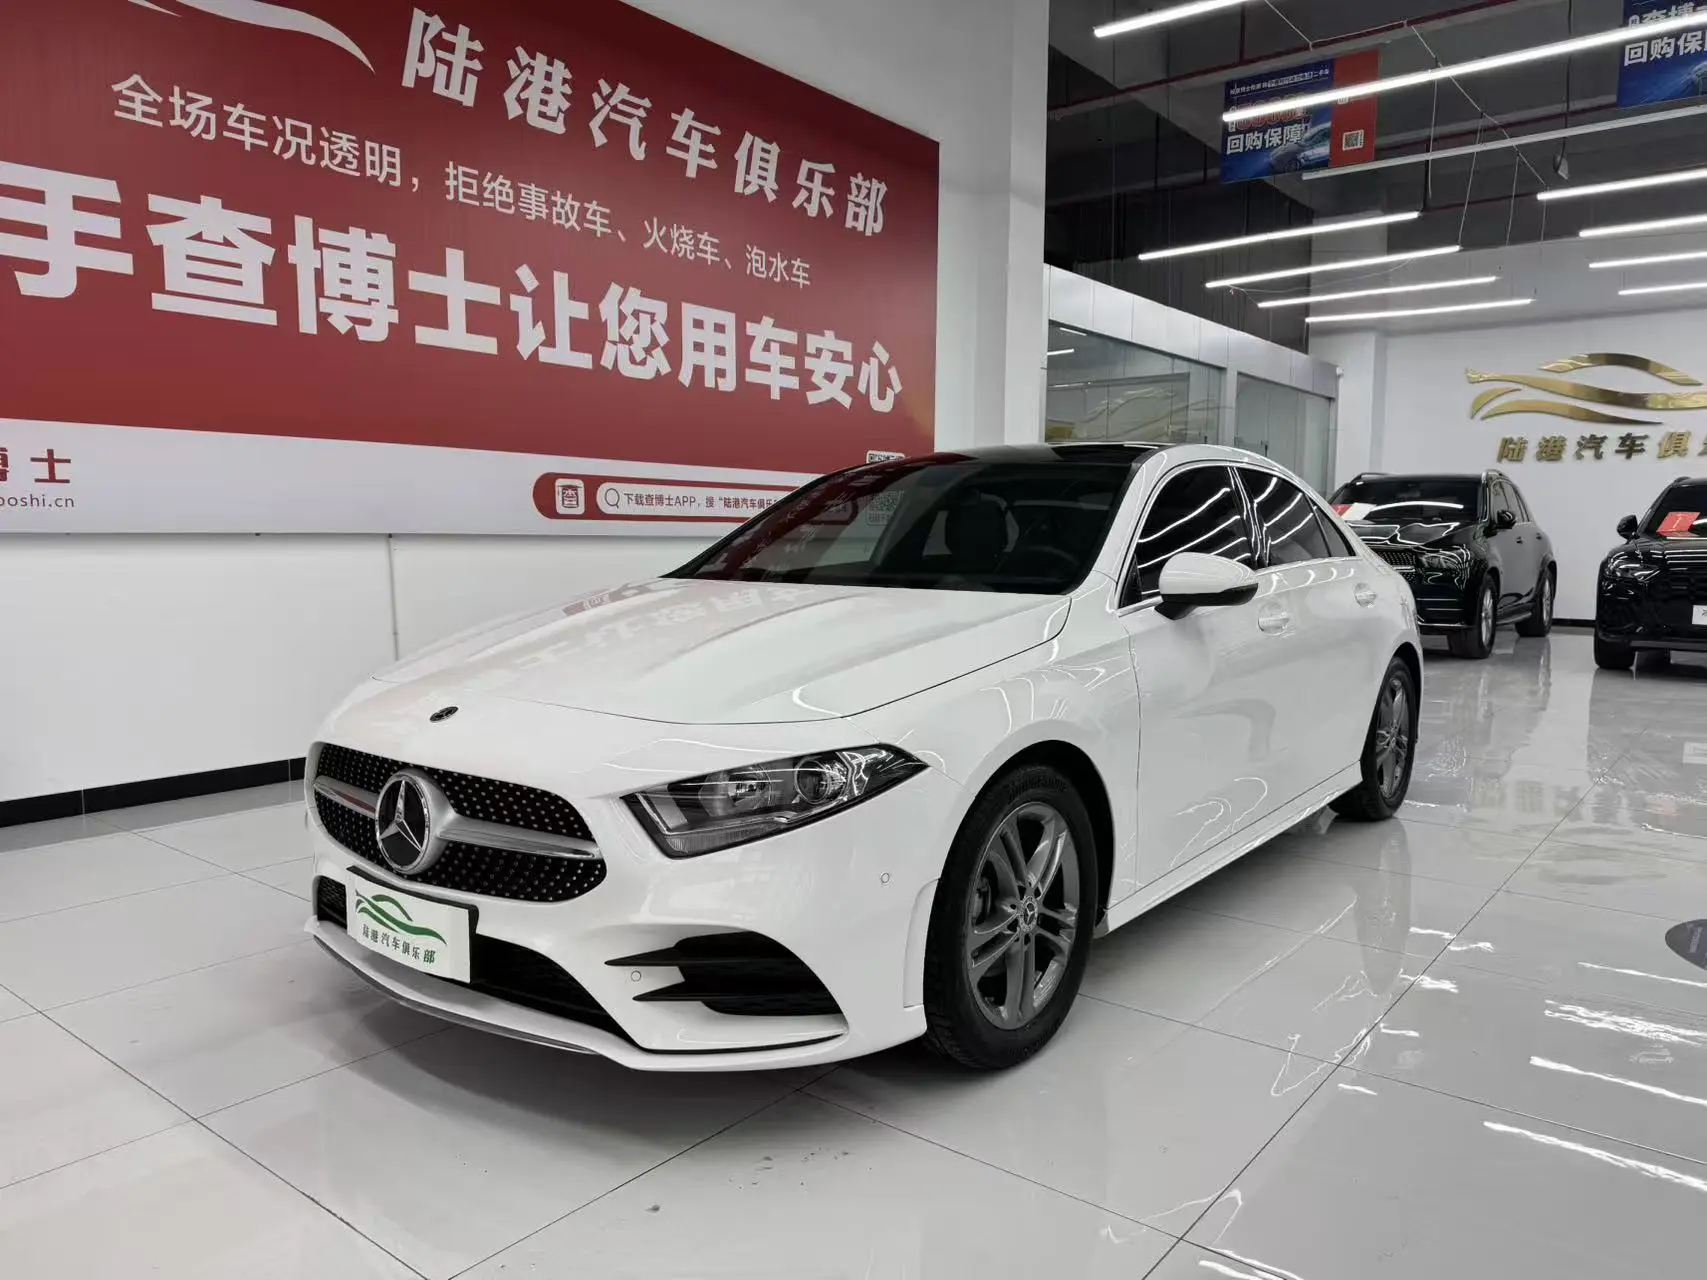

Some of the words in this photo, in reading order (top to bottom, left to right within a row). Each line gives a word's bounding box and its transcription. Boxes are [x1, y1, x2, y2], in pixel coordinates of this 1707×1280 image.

[1624, 30, 1707, 66] 回购保
[401, 8, 888, 237] 陆港汽车俱乐部
[1226, 122, 1304, 155] 回购保障
[0, 161, 903, 413] 手查博士让您用车安心
[1497, 431, 1707, 463] 陆港汽车俱
[0, 448, 71, 484] 士
